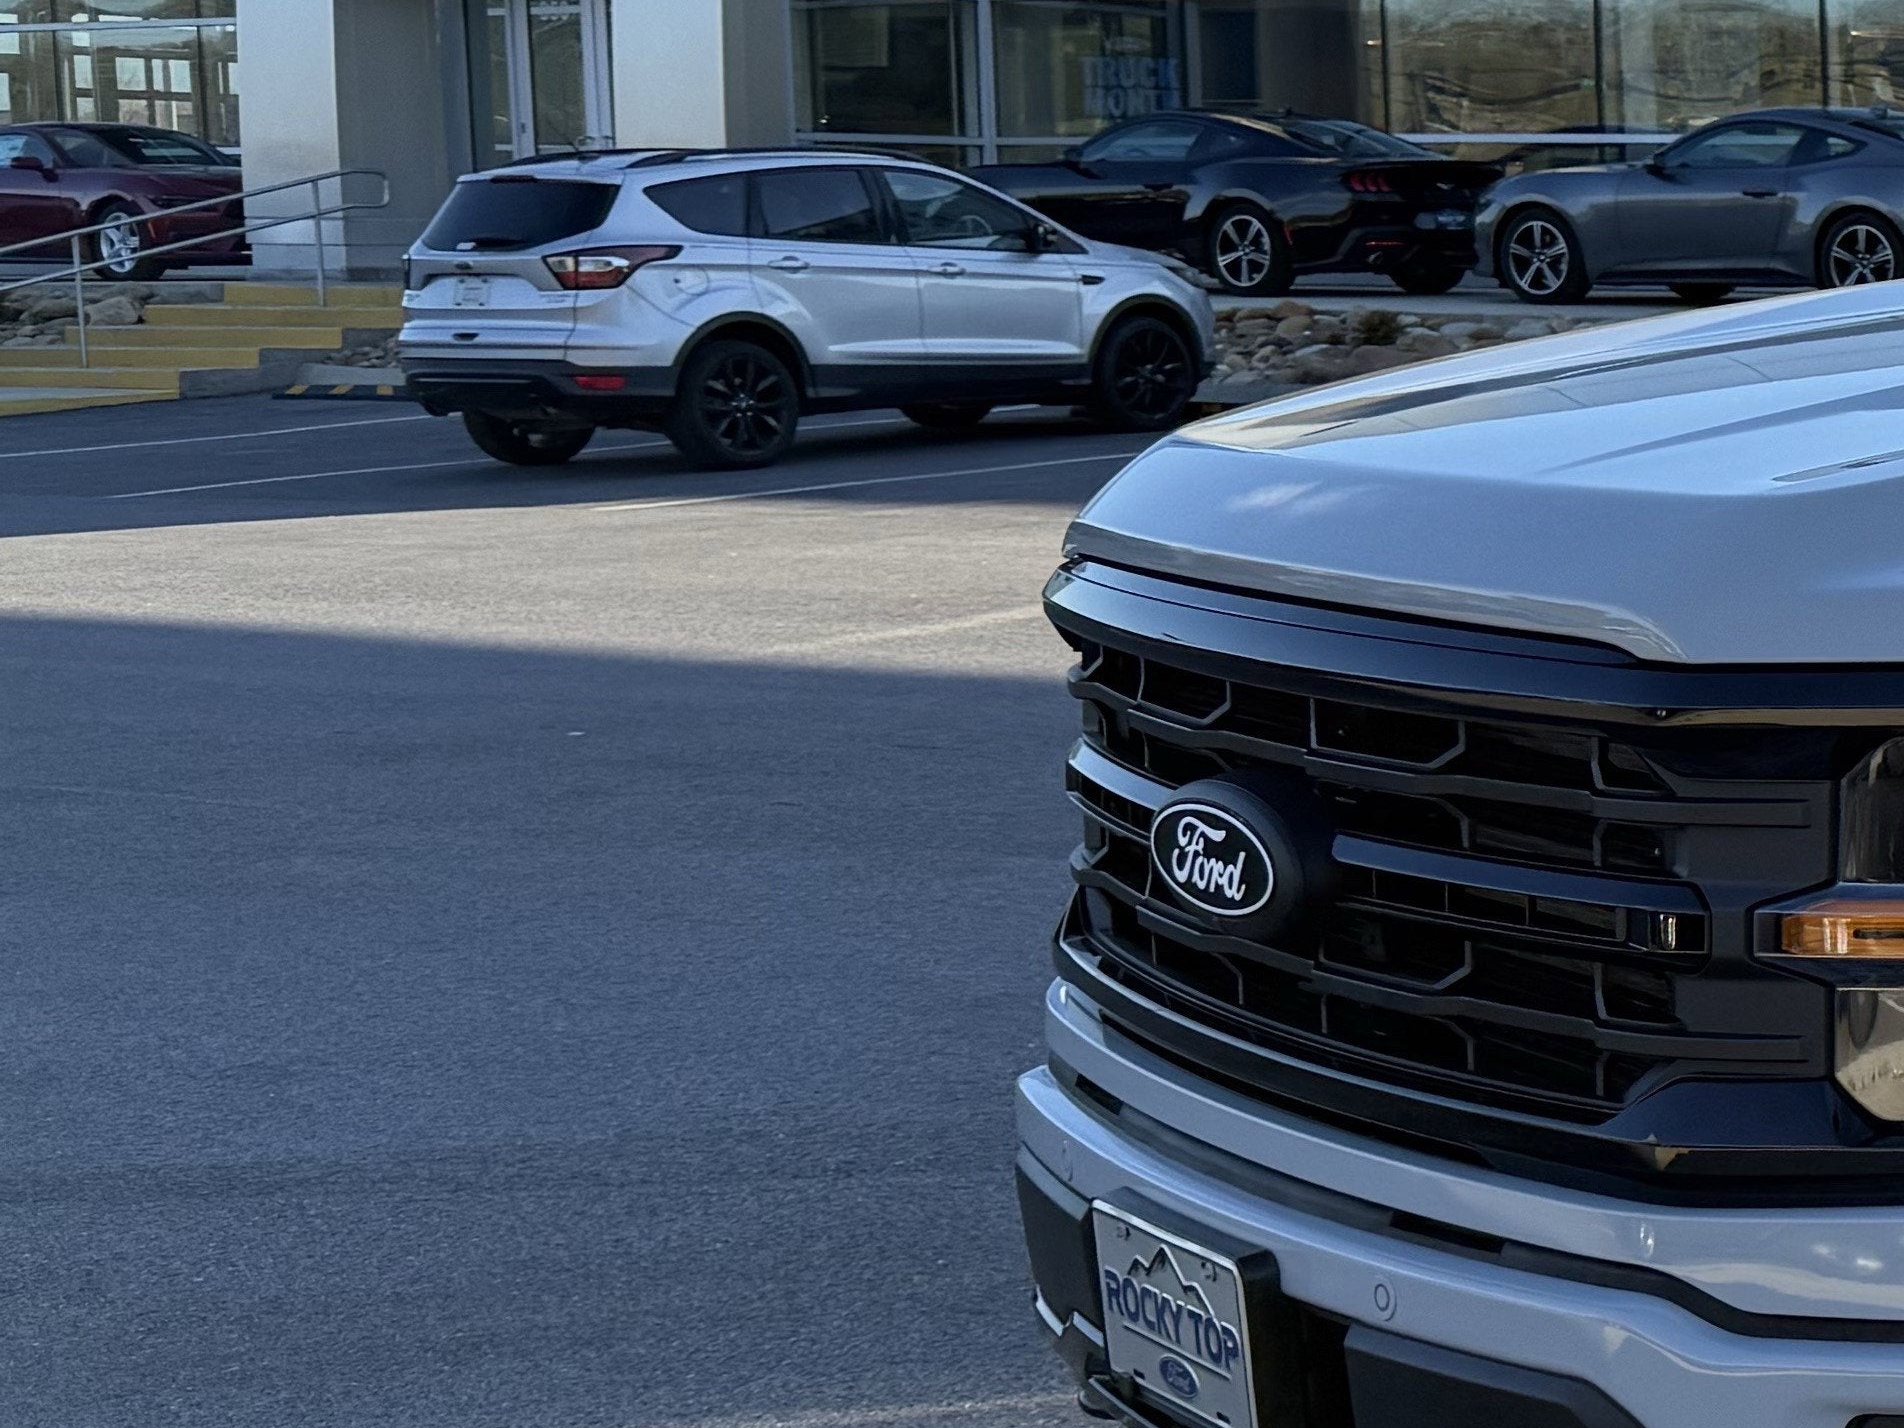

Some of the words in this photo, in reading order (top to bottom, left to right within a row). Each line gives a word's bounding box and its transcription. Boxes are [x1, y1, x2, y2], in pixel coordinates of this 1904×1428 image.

[1172, 815, 1247, 901] Ford
[1103, 1266, 1184, 1346] ROCKY
[1186, 1305, 1240, 1371] TOP
